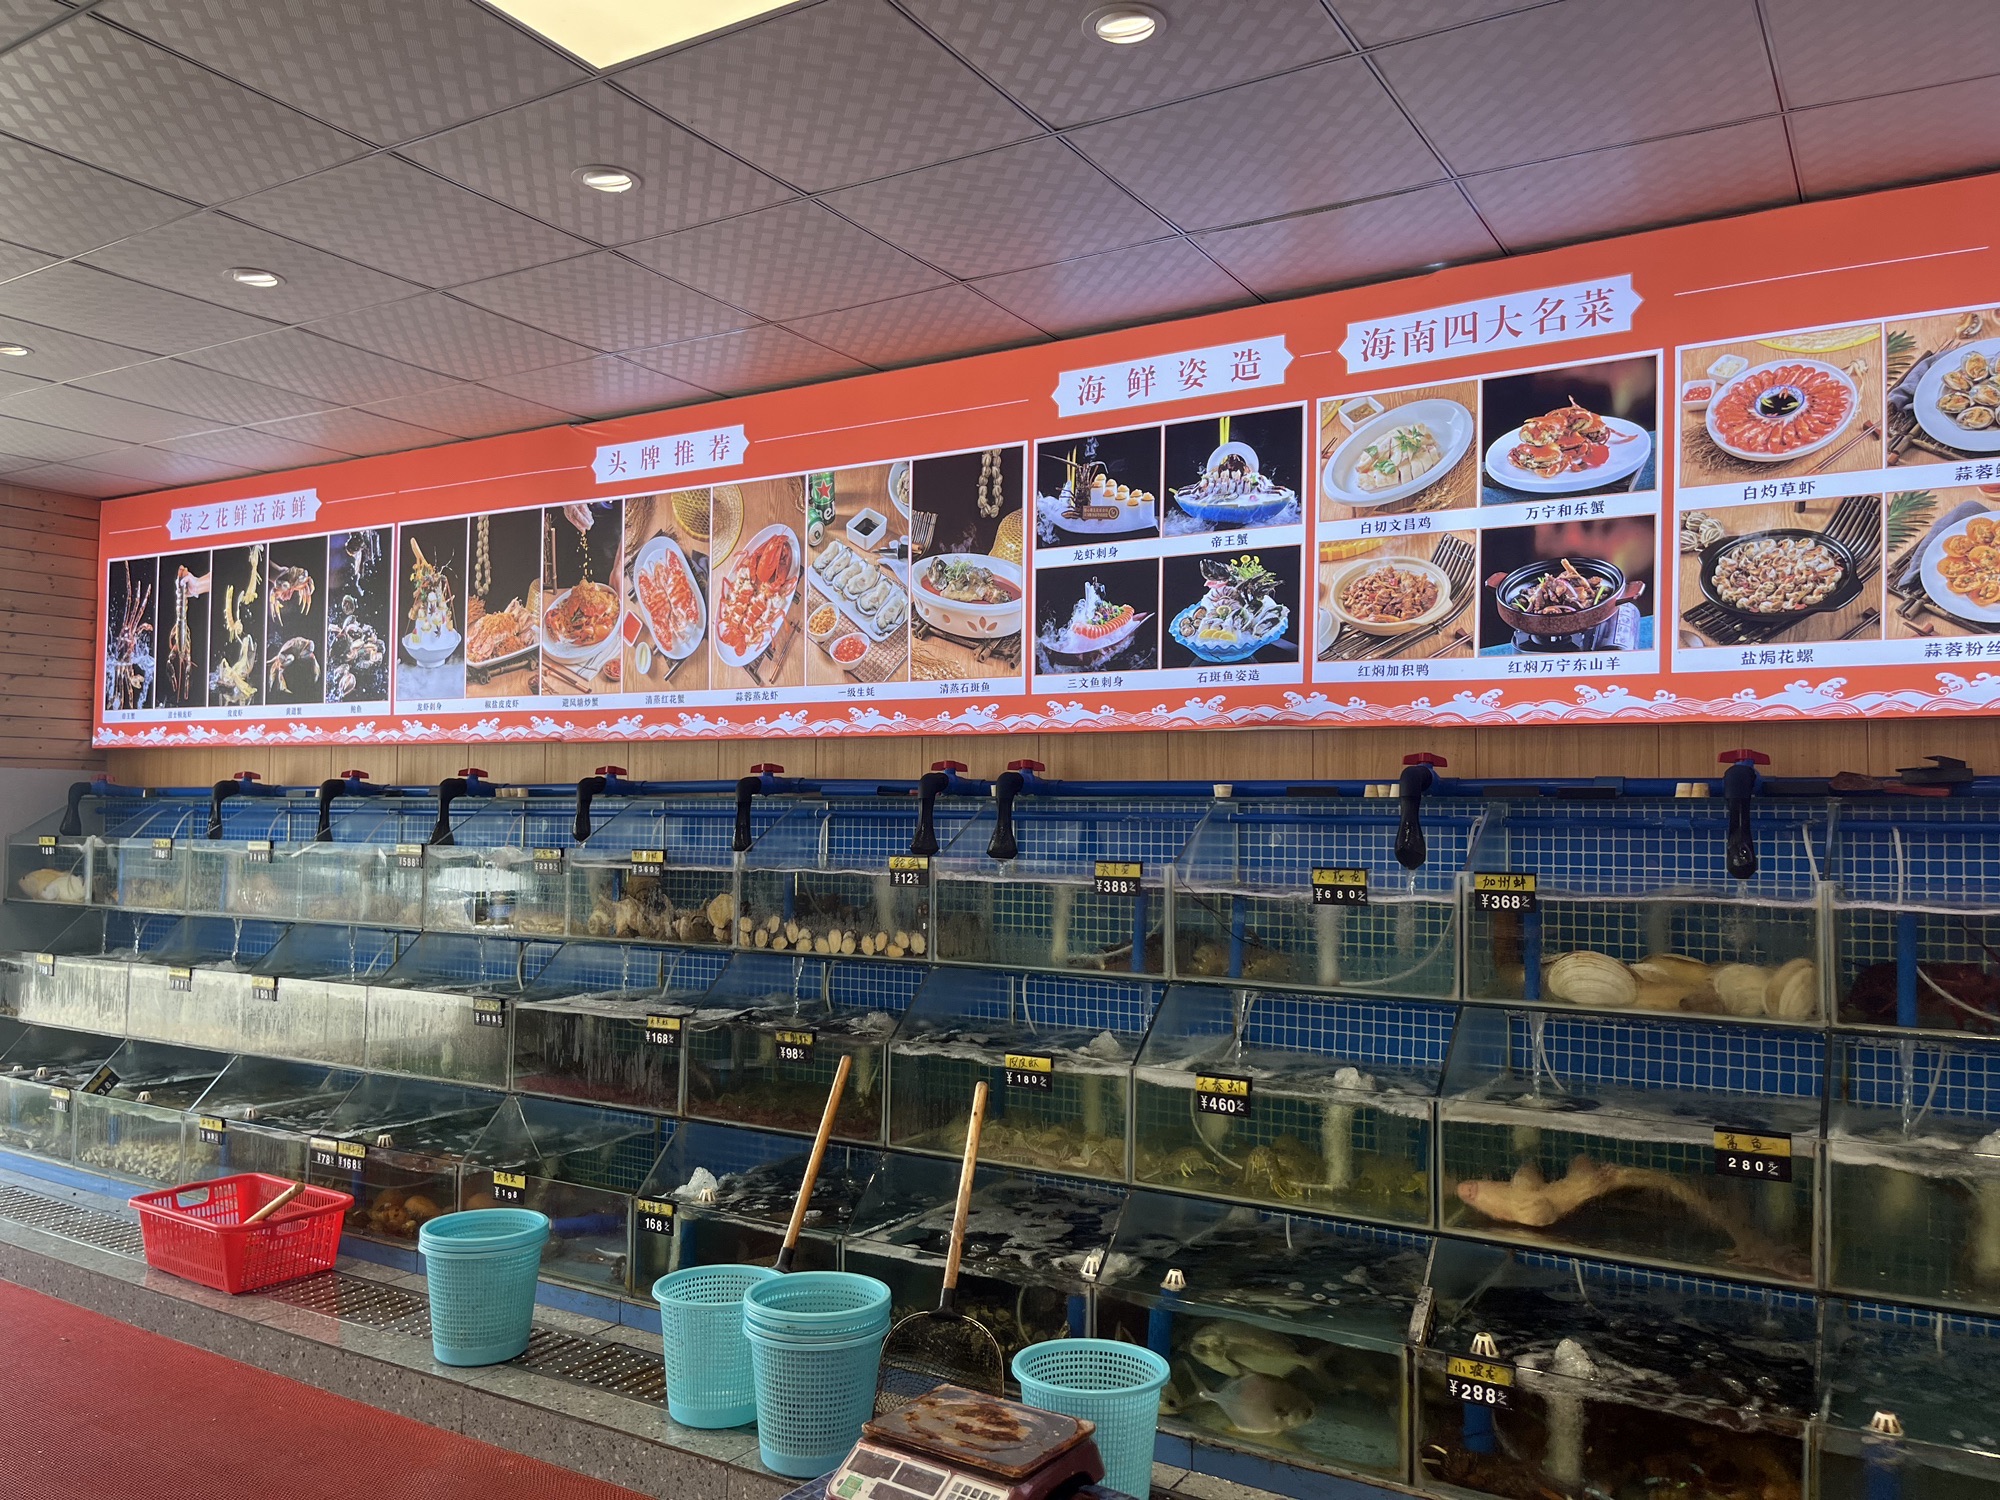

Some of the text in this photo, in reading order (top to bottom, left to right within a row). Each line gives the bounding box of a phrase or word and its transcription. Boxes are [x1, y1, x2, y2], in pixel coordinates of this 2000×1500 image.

[1361, 287, 1615, 361] 海南四大名菜
[1077, 349, 1263, 406] 海鲜姿造
[608, 434, 730, 476] 头牌推荐
[1743, 480, 1816, 499] 白灼草虾
[179, 495, 307, 532] 海之花鲜活海鲜
[1525, 500, 1605, 520] 万宁和乐蟹
[1360, 516, 1431, 535] 白切文昌鸡
[1211, 533, 1248, 547] 帝王蟹
[1073, 545, 1119, 560] 龙虾刺身
[1508, 655, 1620, 674] 红焖万宁东山羊
[1741, 648, 1814, 665] 盐焗花螺
[1197, 668, 1260, 684] 石斑鱼姿造
[1357, 658, 1429, 677] 红焖加积鸭
[940, 682, 991, 694] 清蒸石斑鱼
[1068, 674, 1123, 689] 三文鱼刺身
